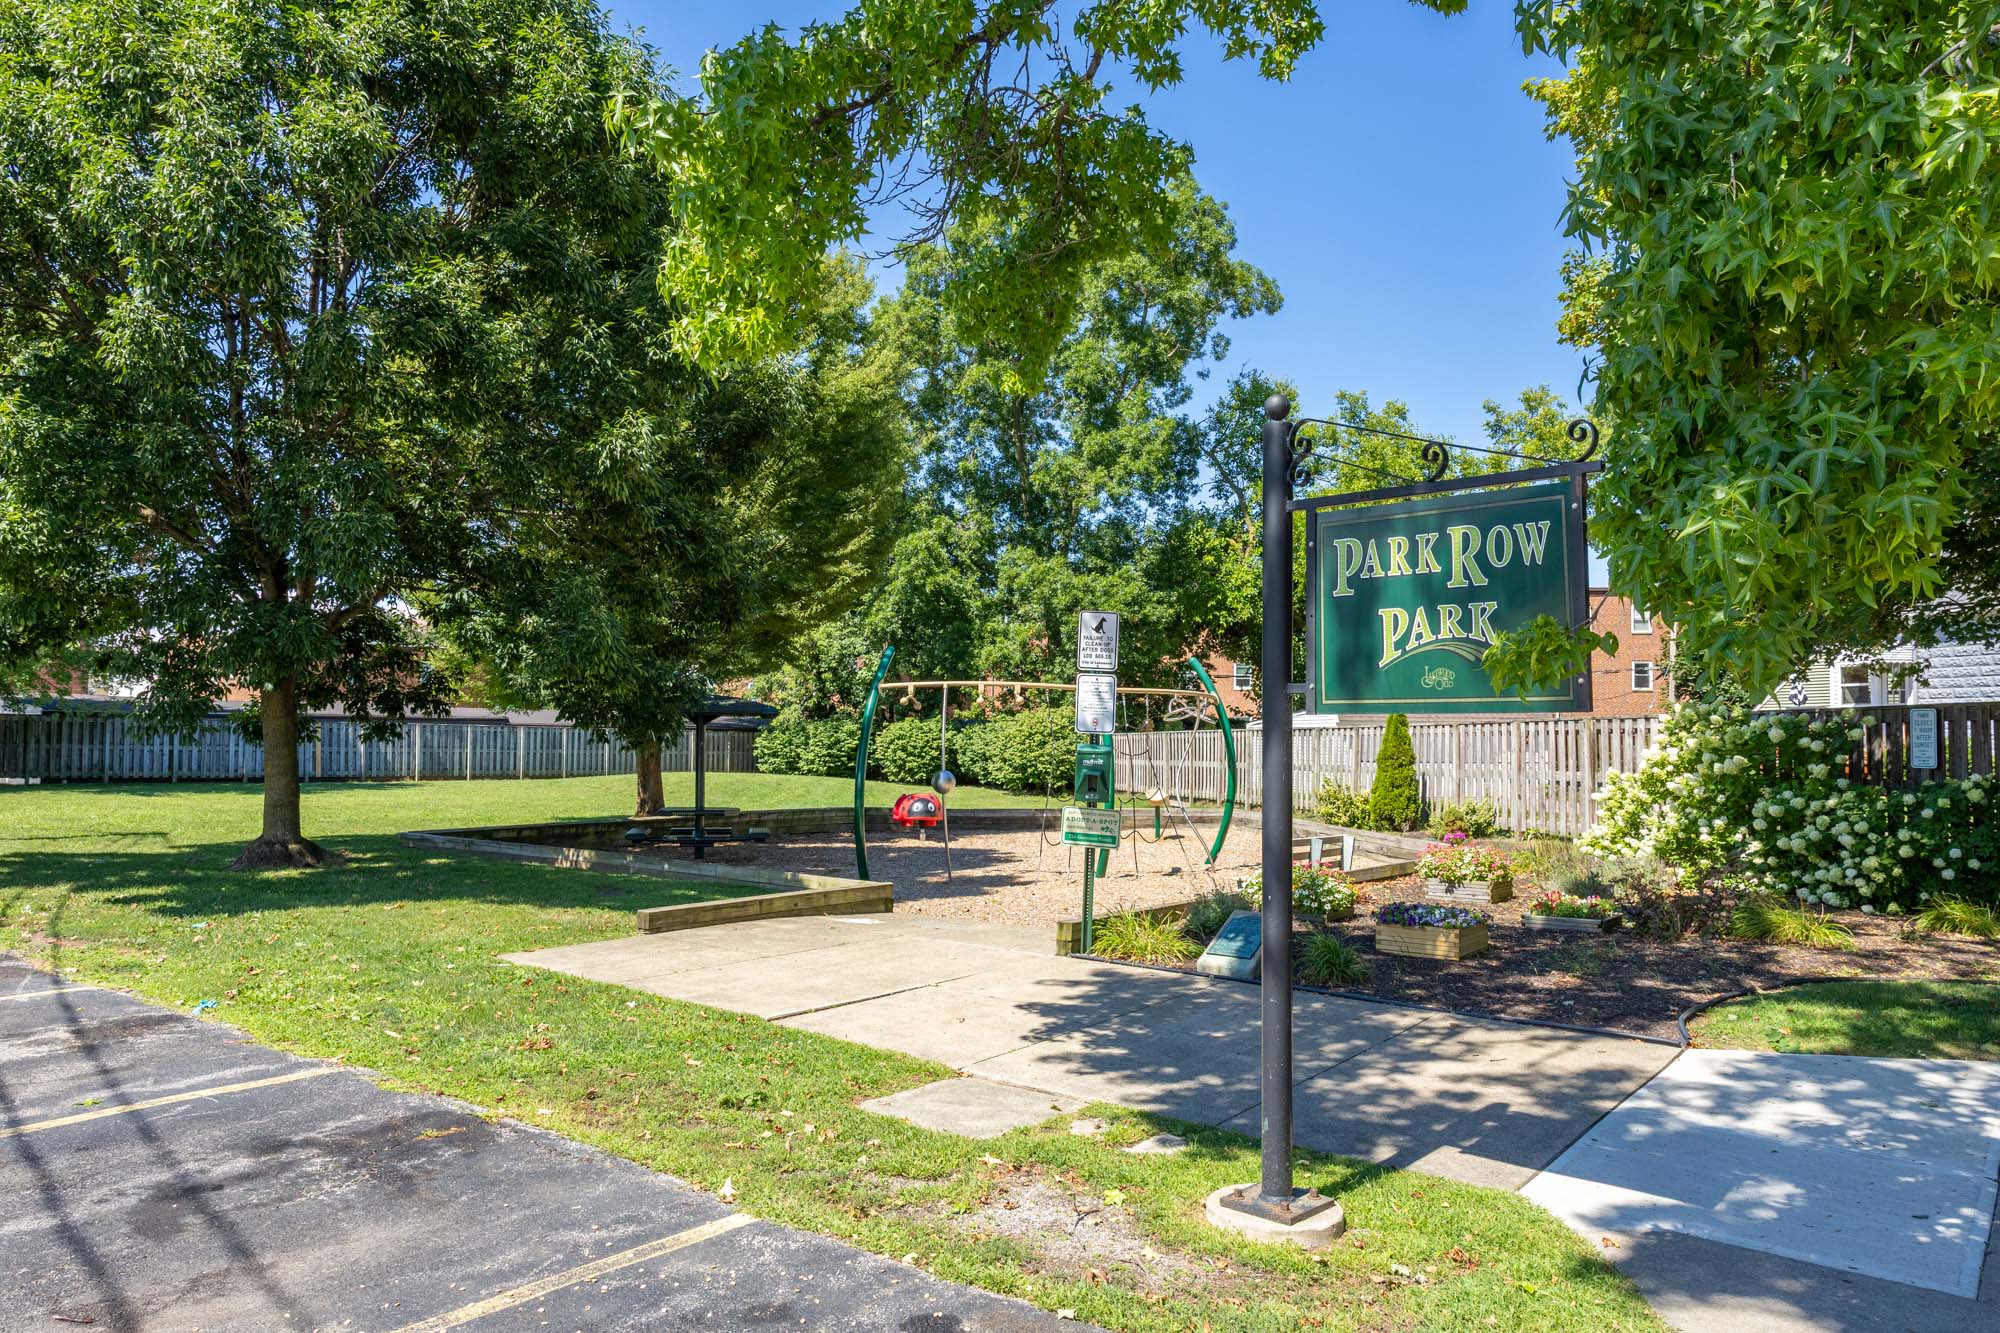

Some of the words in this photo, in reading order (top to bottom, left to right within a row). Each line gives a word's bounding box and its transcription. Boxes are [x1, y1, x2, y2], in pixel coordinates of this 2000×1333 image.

[1333, 532, 1442, 597] PARK
[1447, 520, 1550, 588] ROW
[1378, 601, 1498, 669] PARK
